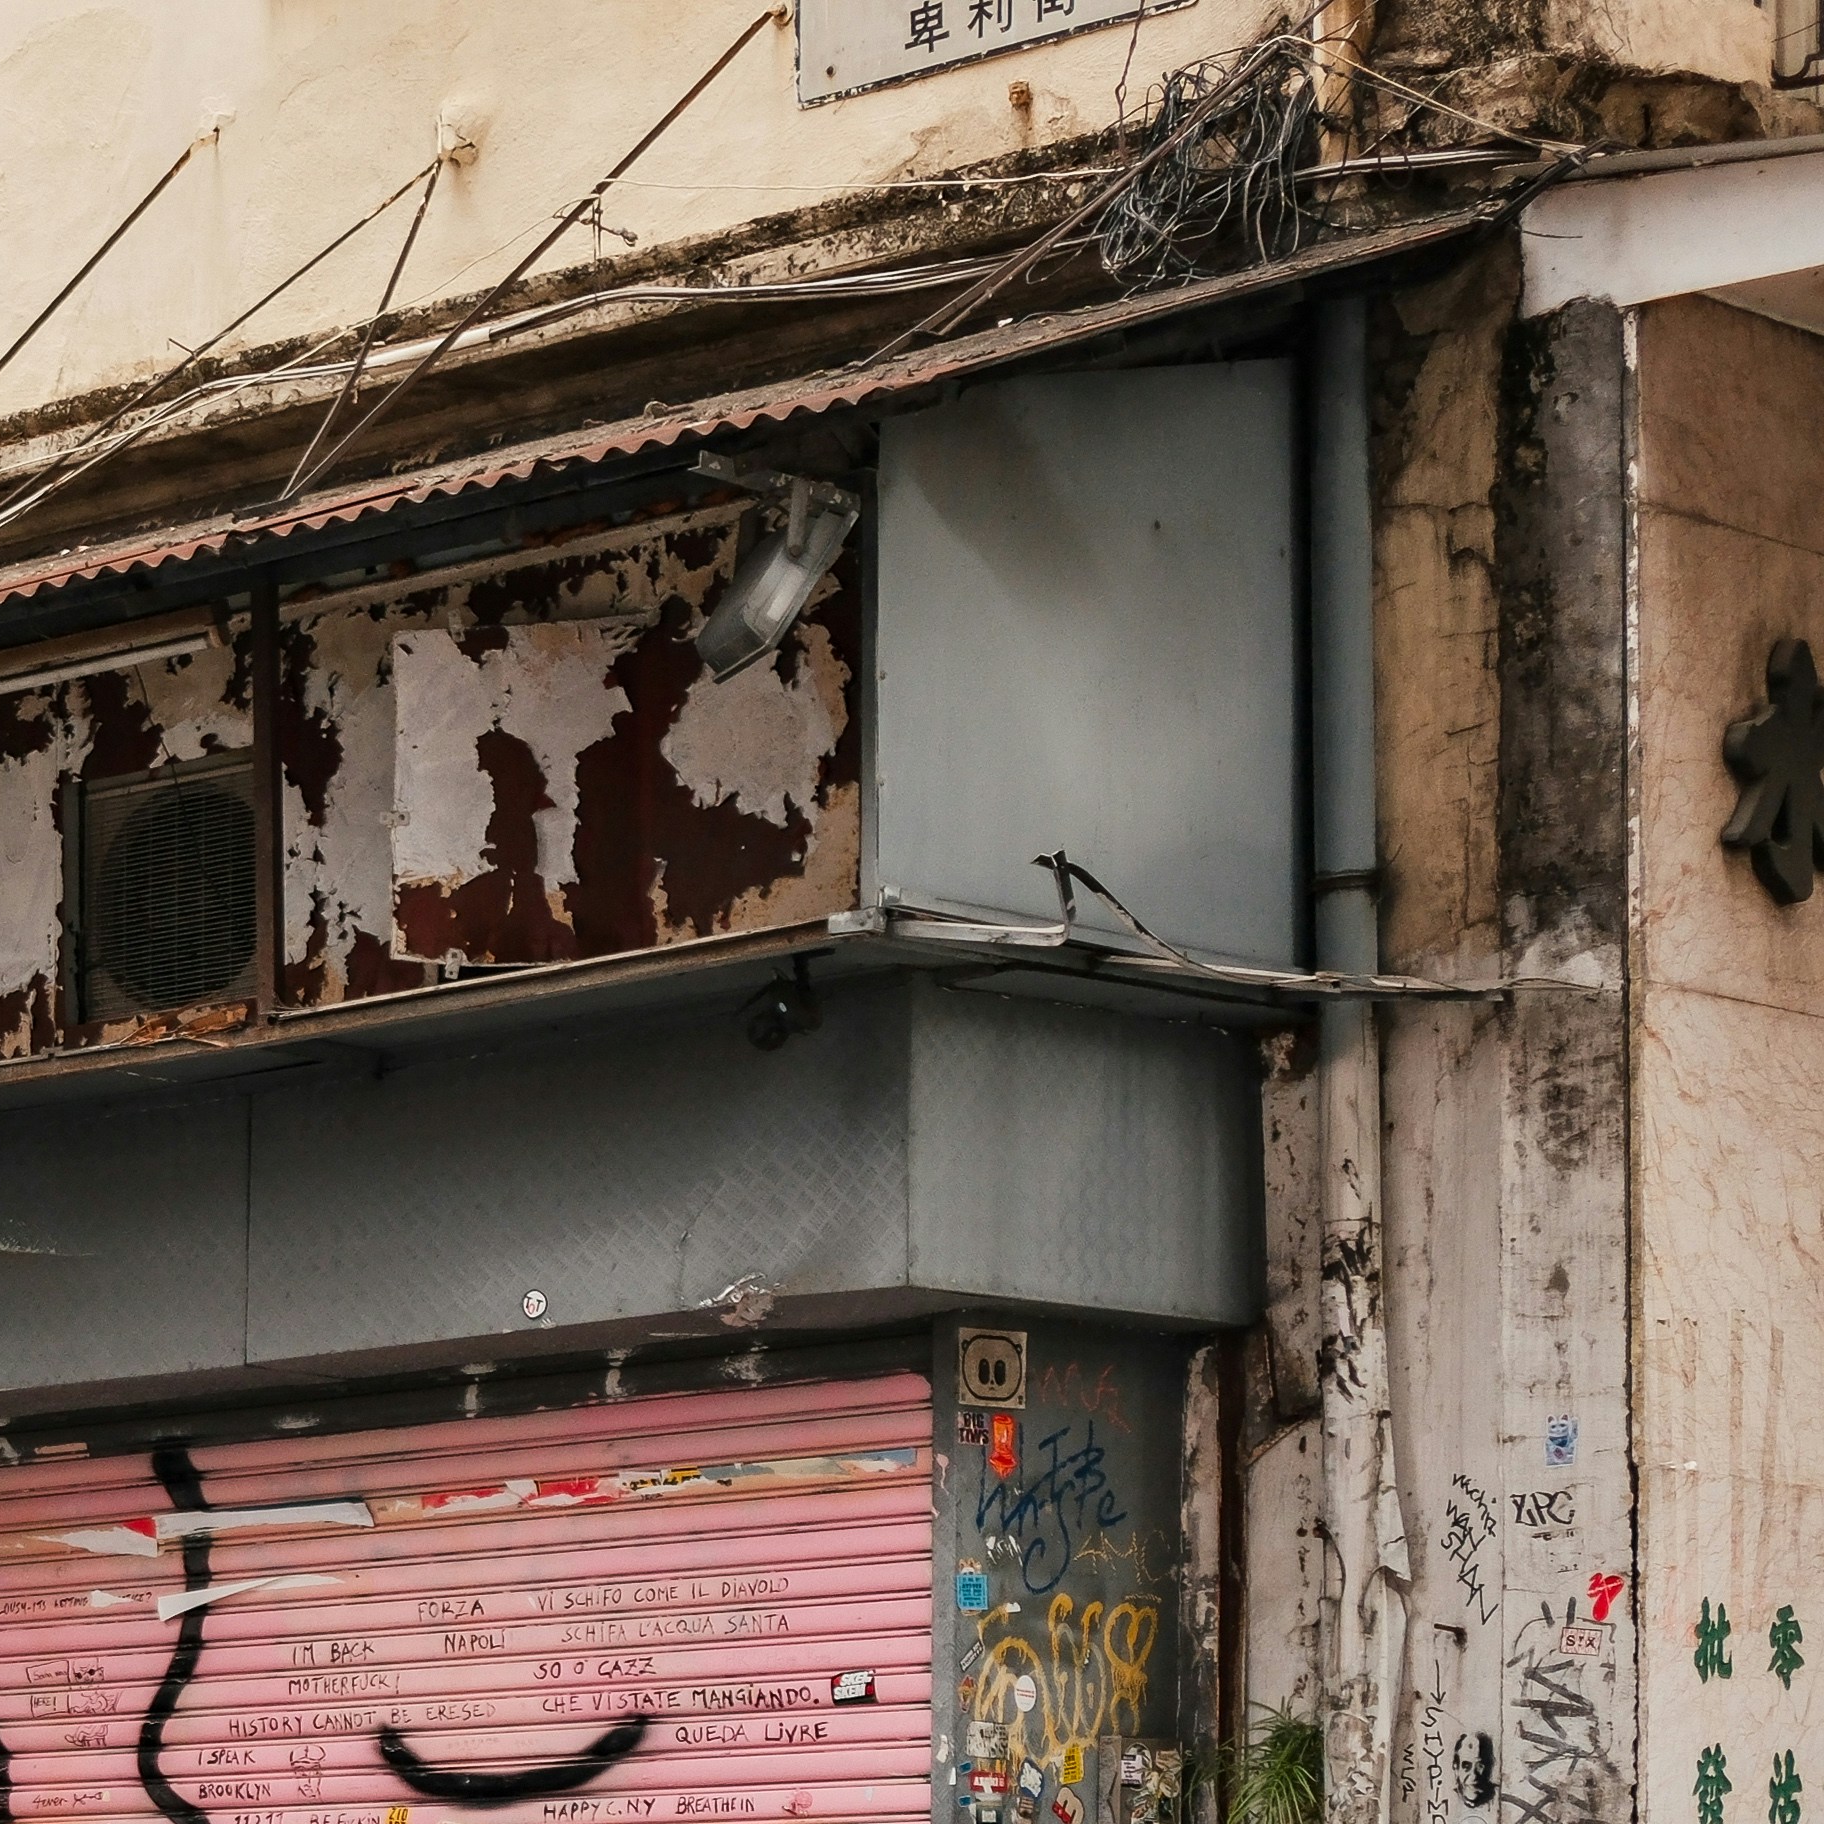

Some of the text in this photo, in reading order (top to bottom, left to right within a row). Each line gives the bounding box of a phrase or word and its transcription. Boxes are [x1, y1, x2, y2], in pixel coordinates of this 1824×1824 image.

[963, 1412, 985, 1428] BIG
[633, 1585, 680, 1603] COME
[691, 1582, 711, 1599] IL
[418, 1600, 485, 1622] FORZA
[724, 1613, 790, 1635] SANTA
[330, 1640, 376, 1664] BACK
[542, 1694, 579, 1713] CHE
[229, 1715, 303, 1738] HISTORY
[312, 1710, 377, 1732] CANNOT
[391, 1707, 412, 1725] BE
[675, 1725, 748, 1745] QUEDA
[198, 1781, 273, 1801] BROOKLYN
[543, 1800, 602, 1823] HAPPY
